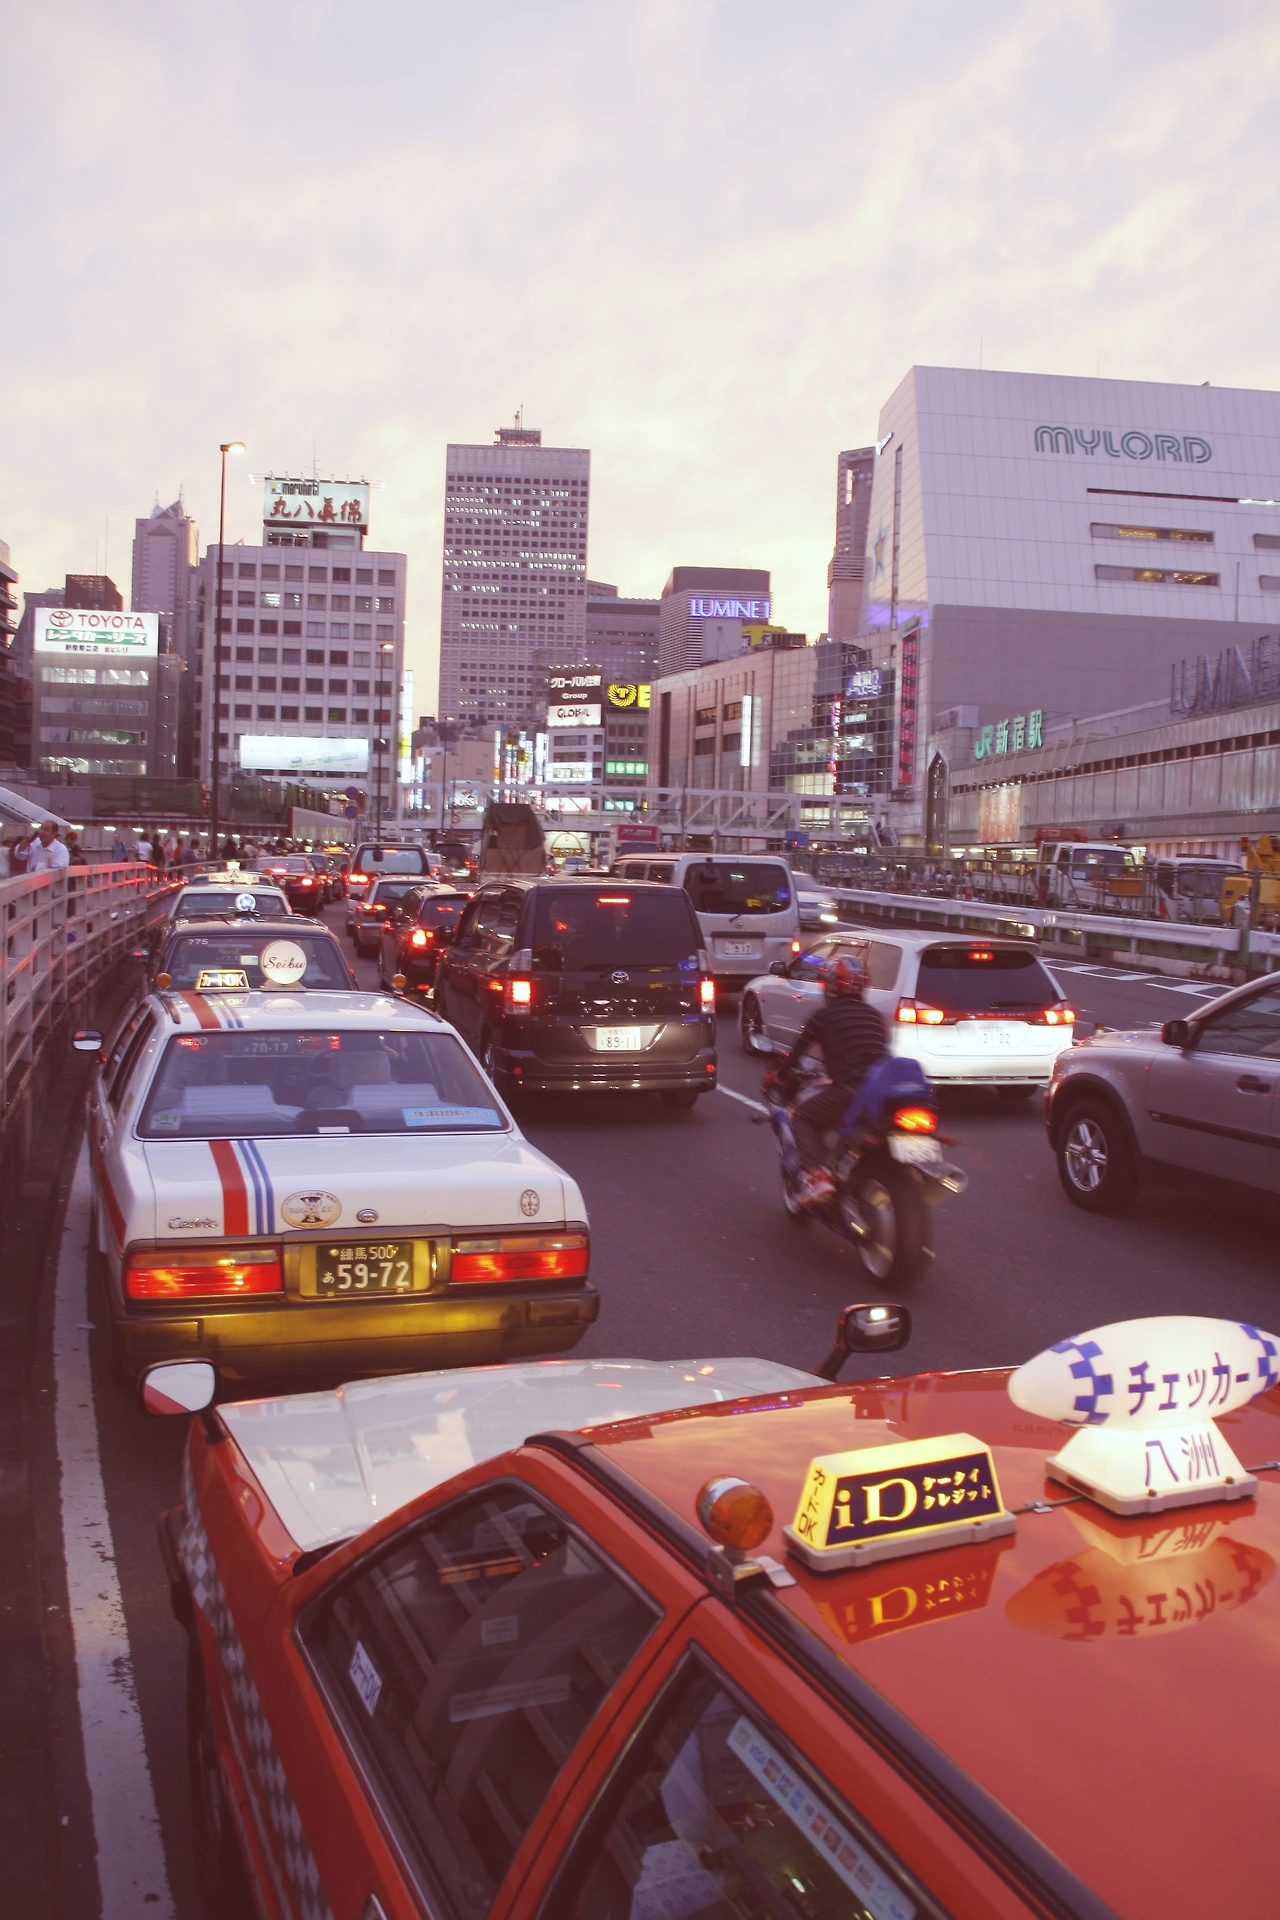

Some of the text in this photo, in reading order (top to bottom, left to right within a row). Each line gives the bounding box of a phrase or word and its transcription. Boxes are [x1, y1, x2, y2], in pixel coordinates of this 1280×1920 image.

[1034, 425, 1213, 464] MYLORD
[690, 598, 761, 618] LUMINE
[77, 614, 146, 630] TOYOTA
[561, 692, 588, 701] Group
[262, 956, 306, 970] Seibu
[606, 1036, 637, 1049] 89-11
[369, 1246, 394, 1260] 500
[337, 1261, 410, 1290] 59-72
[1128, 1351, 1250, 1416] チェッカー
[1145, 1431, 1220, 1487] 八洲
[922, 1467, 980, 1492] ケータイ
[834, 1477, 918, 1531] iD
[923, 1484, 992, 1511] クレジット
